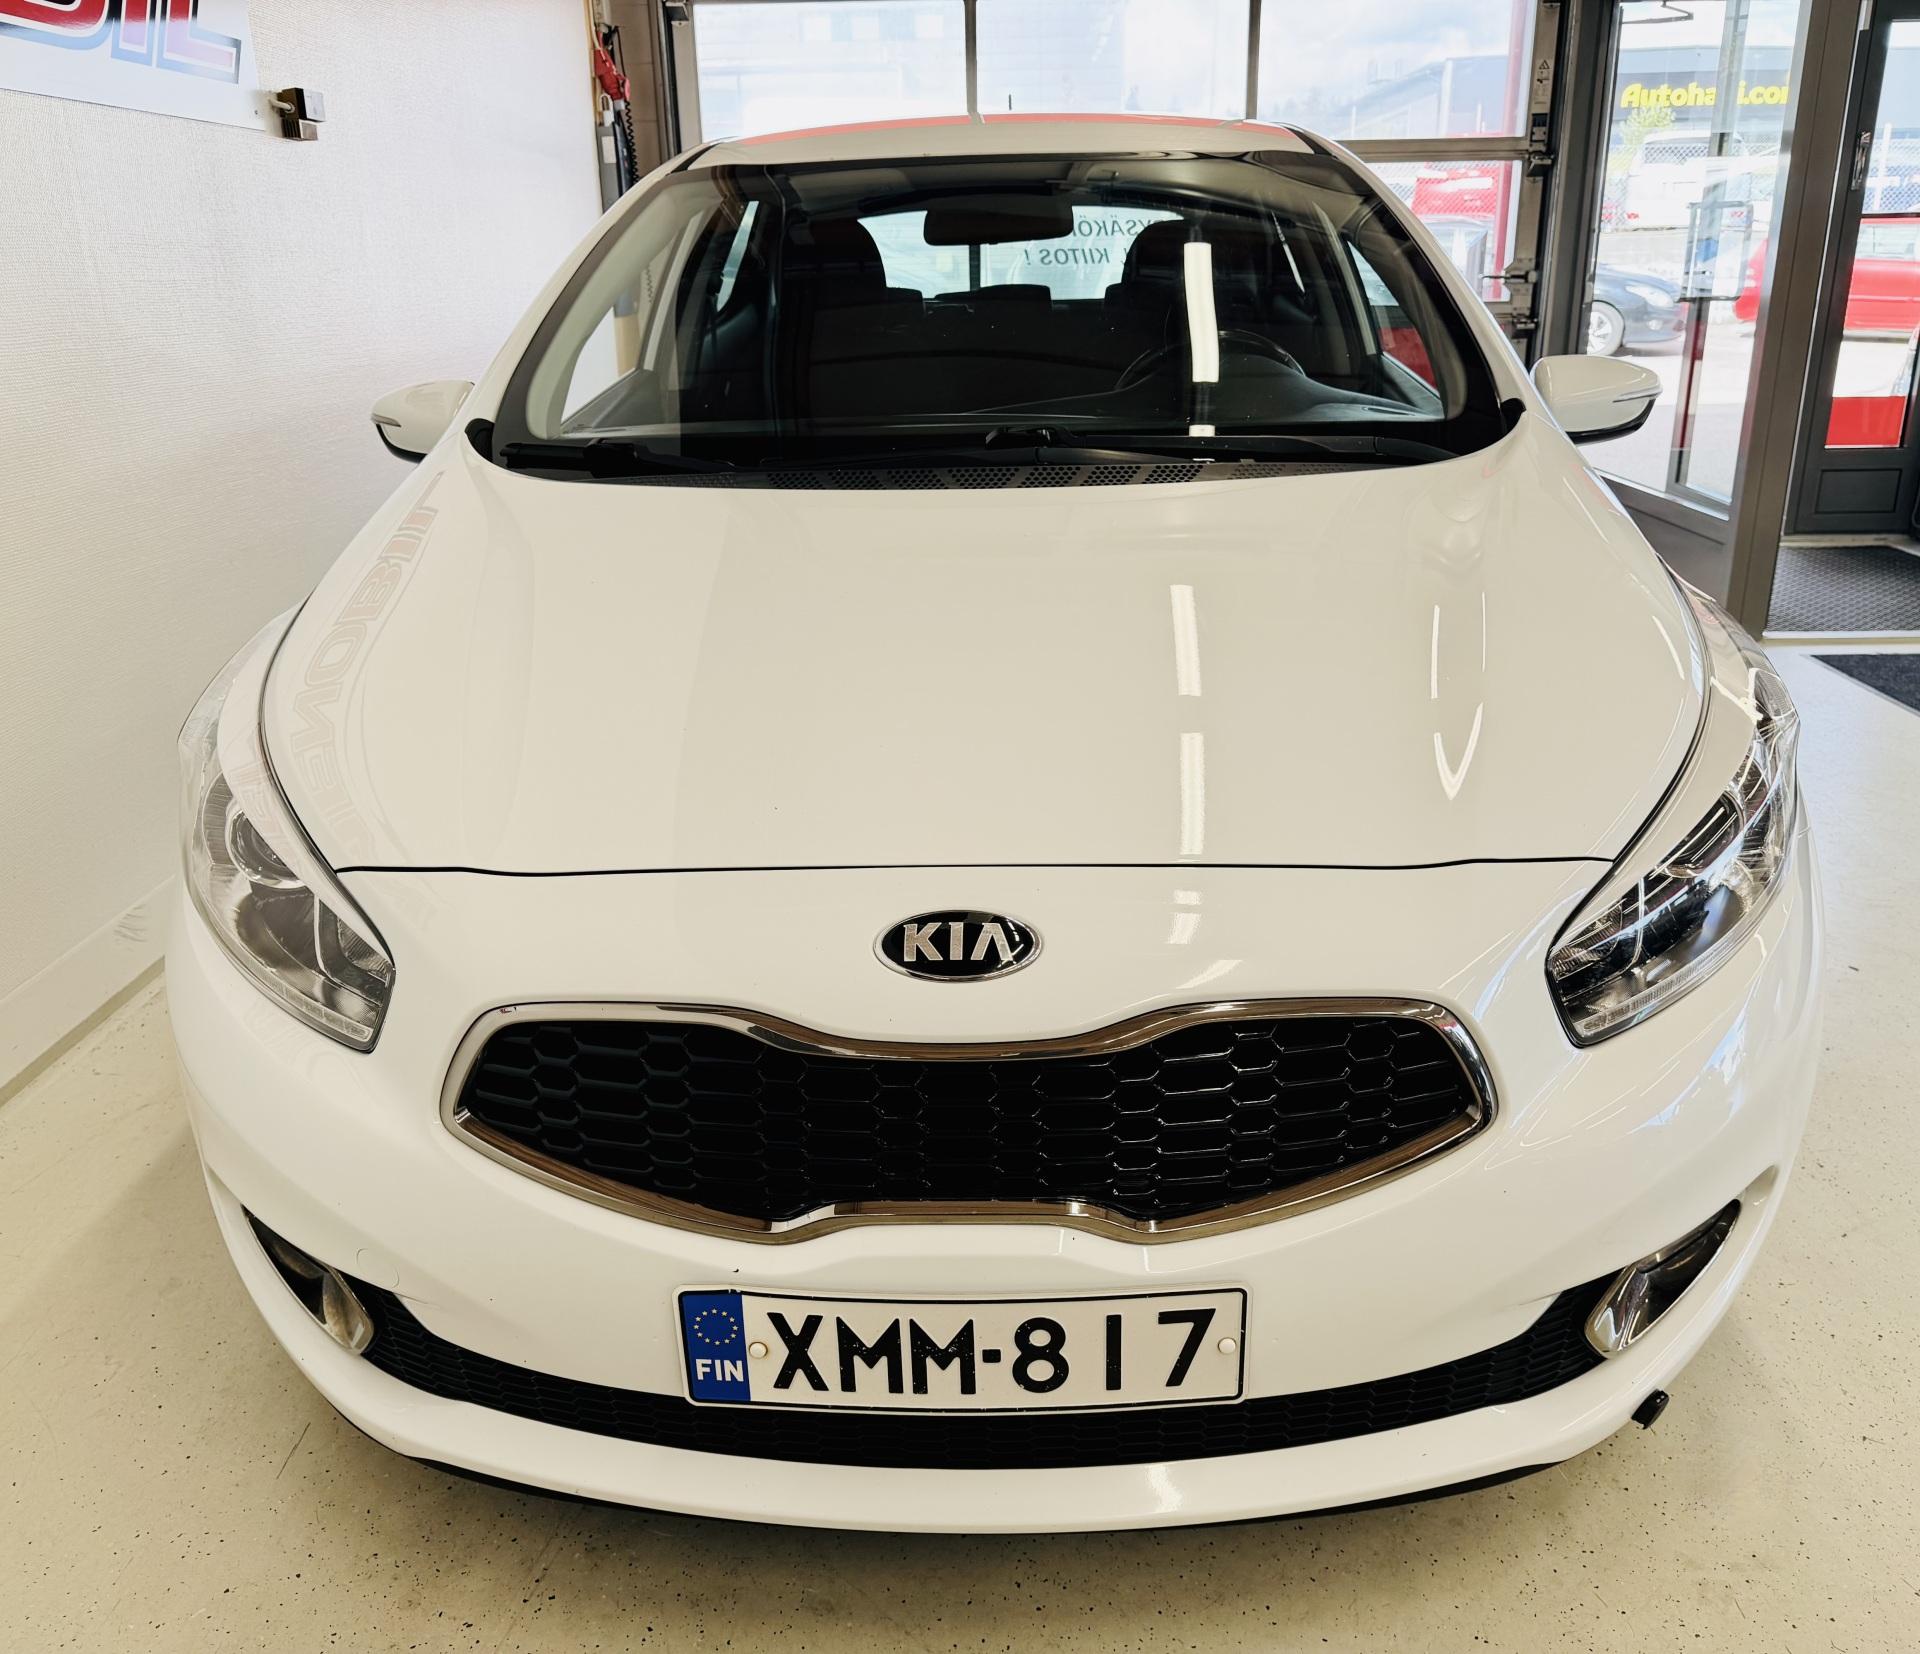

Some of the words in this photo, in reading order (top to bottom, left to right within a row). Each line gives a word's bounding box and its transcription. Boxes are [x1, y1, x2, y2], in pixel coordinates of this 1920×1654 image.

[1620, 80, 1789, 108] Autohai.co
[903, 921, 1014, 962] KIA
[766, 1307, 1217, 1395] XMM-817
[695, 1357, 745, 1383] FIN
